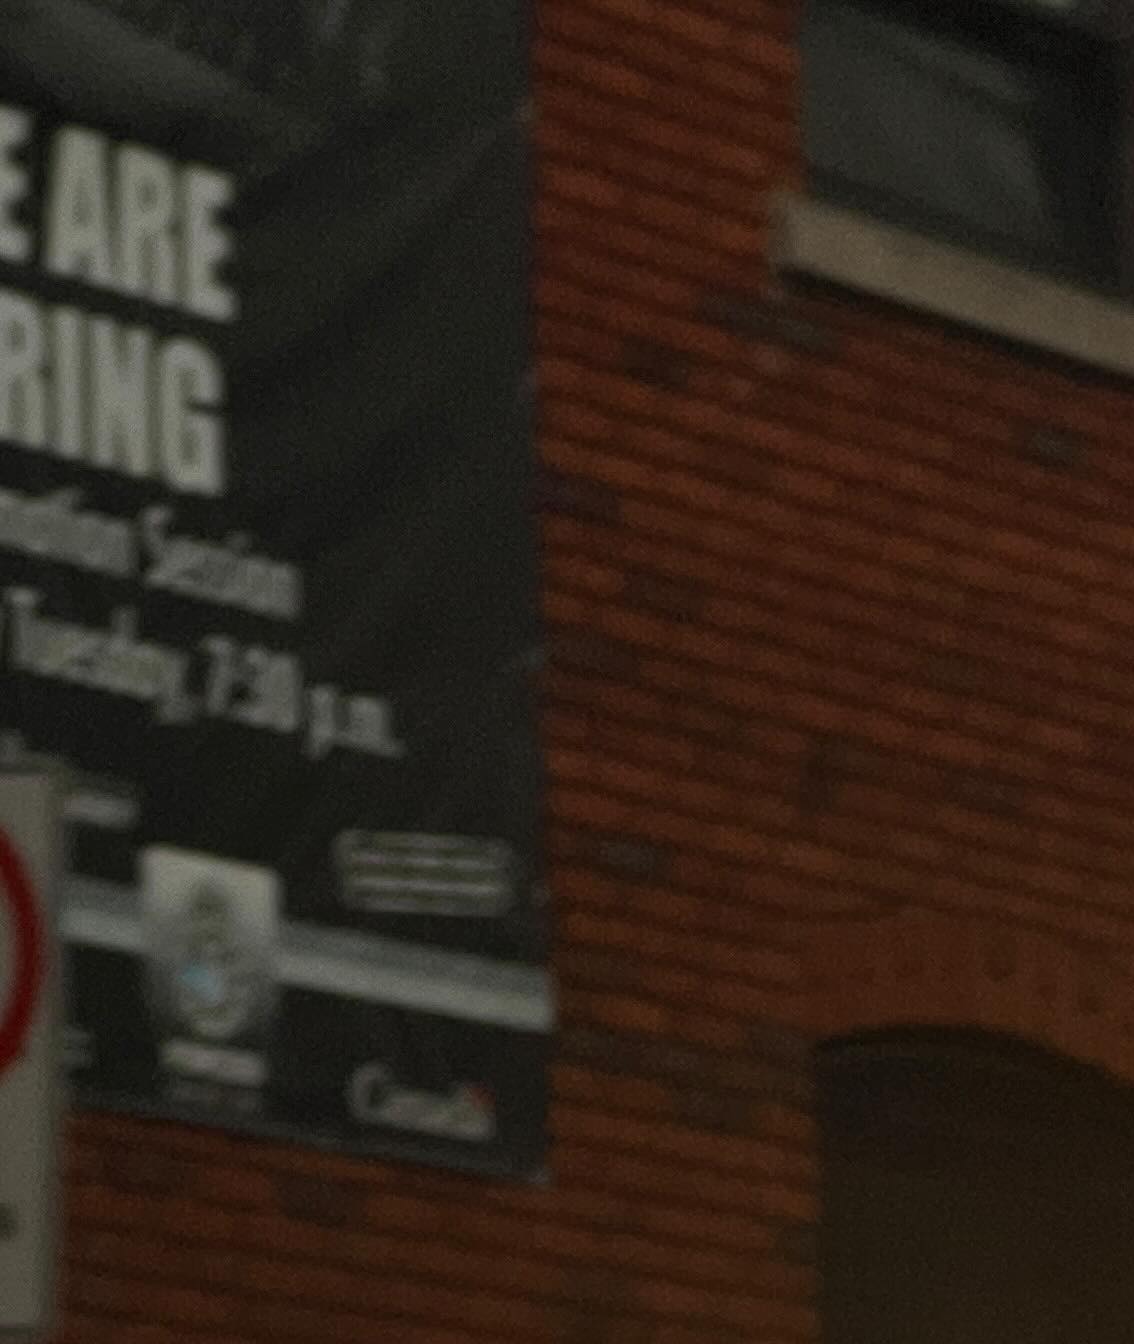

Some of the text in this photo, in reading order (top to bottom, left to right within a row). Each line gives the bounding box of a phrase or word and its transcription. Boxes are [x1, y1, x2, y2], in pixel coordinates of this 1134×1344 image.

[44, 123, 239, 325] ARE
[0, 290, 224, 497] RING
[143, 506, 302, 619] Session
[200, 636, 301, 733] 7:30
